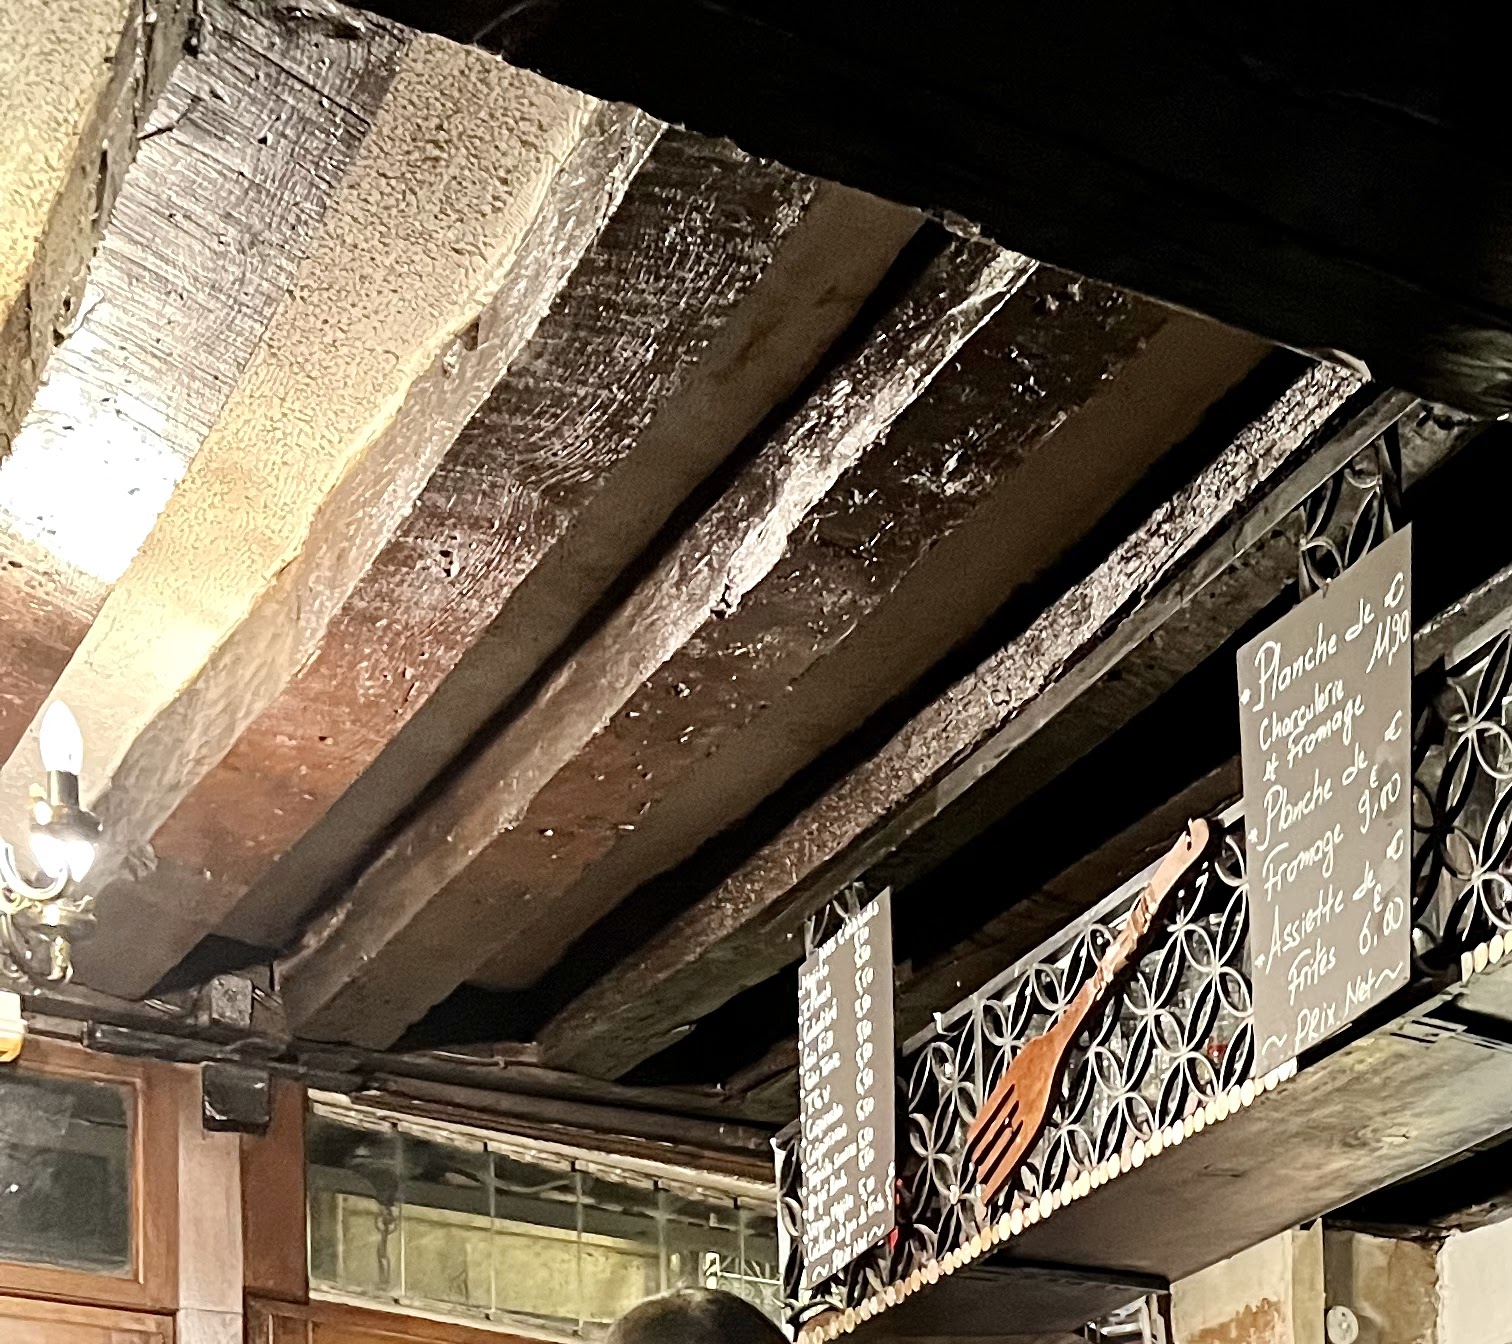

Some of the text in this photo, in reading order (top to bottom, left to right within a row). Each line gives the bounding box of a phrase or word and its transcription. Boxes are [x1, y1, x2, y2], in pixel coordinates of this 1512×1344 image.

[1252, 623, 1337, 712] Planche
[1345, 598, 1375, 642] de
[1287, 694, 1364, 769] Fromage
[1256, 778, 1333, 851] Planche
[1342, 743, 1368, 786] de
[1263, 823, 1344, 902] Fromage
[1265, 884, 1344, 975] Assiette
[1353, 861, 1376, 901] de
[1288, 938, 1336, 1006] Frites
[1344, 968, 1376, 1022] Net
